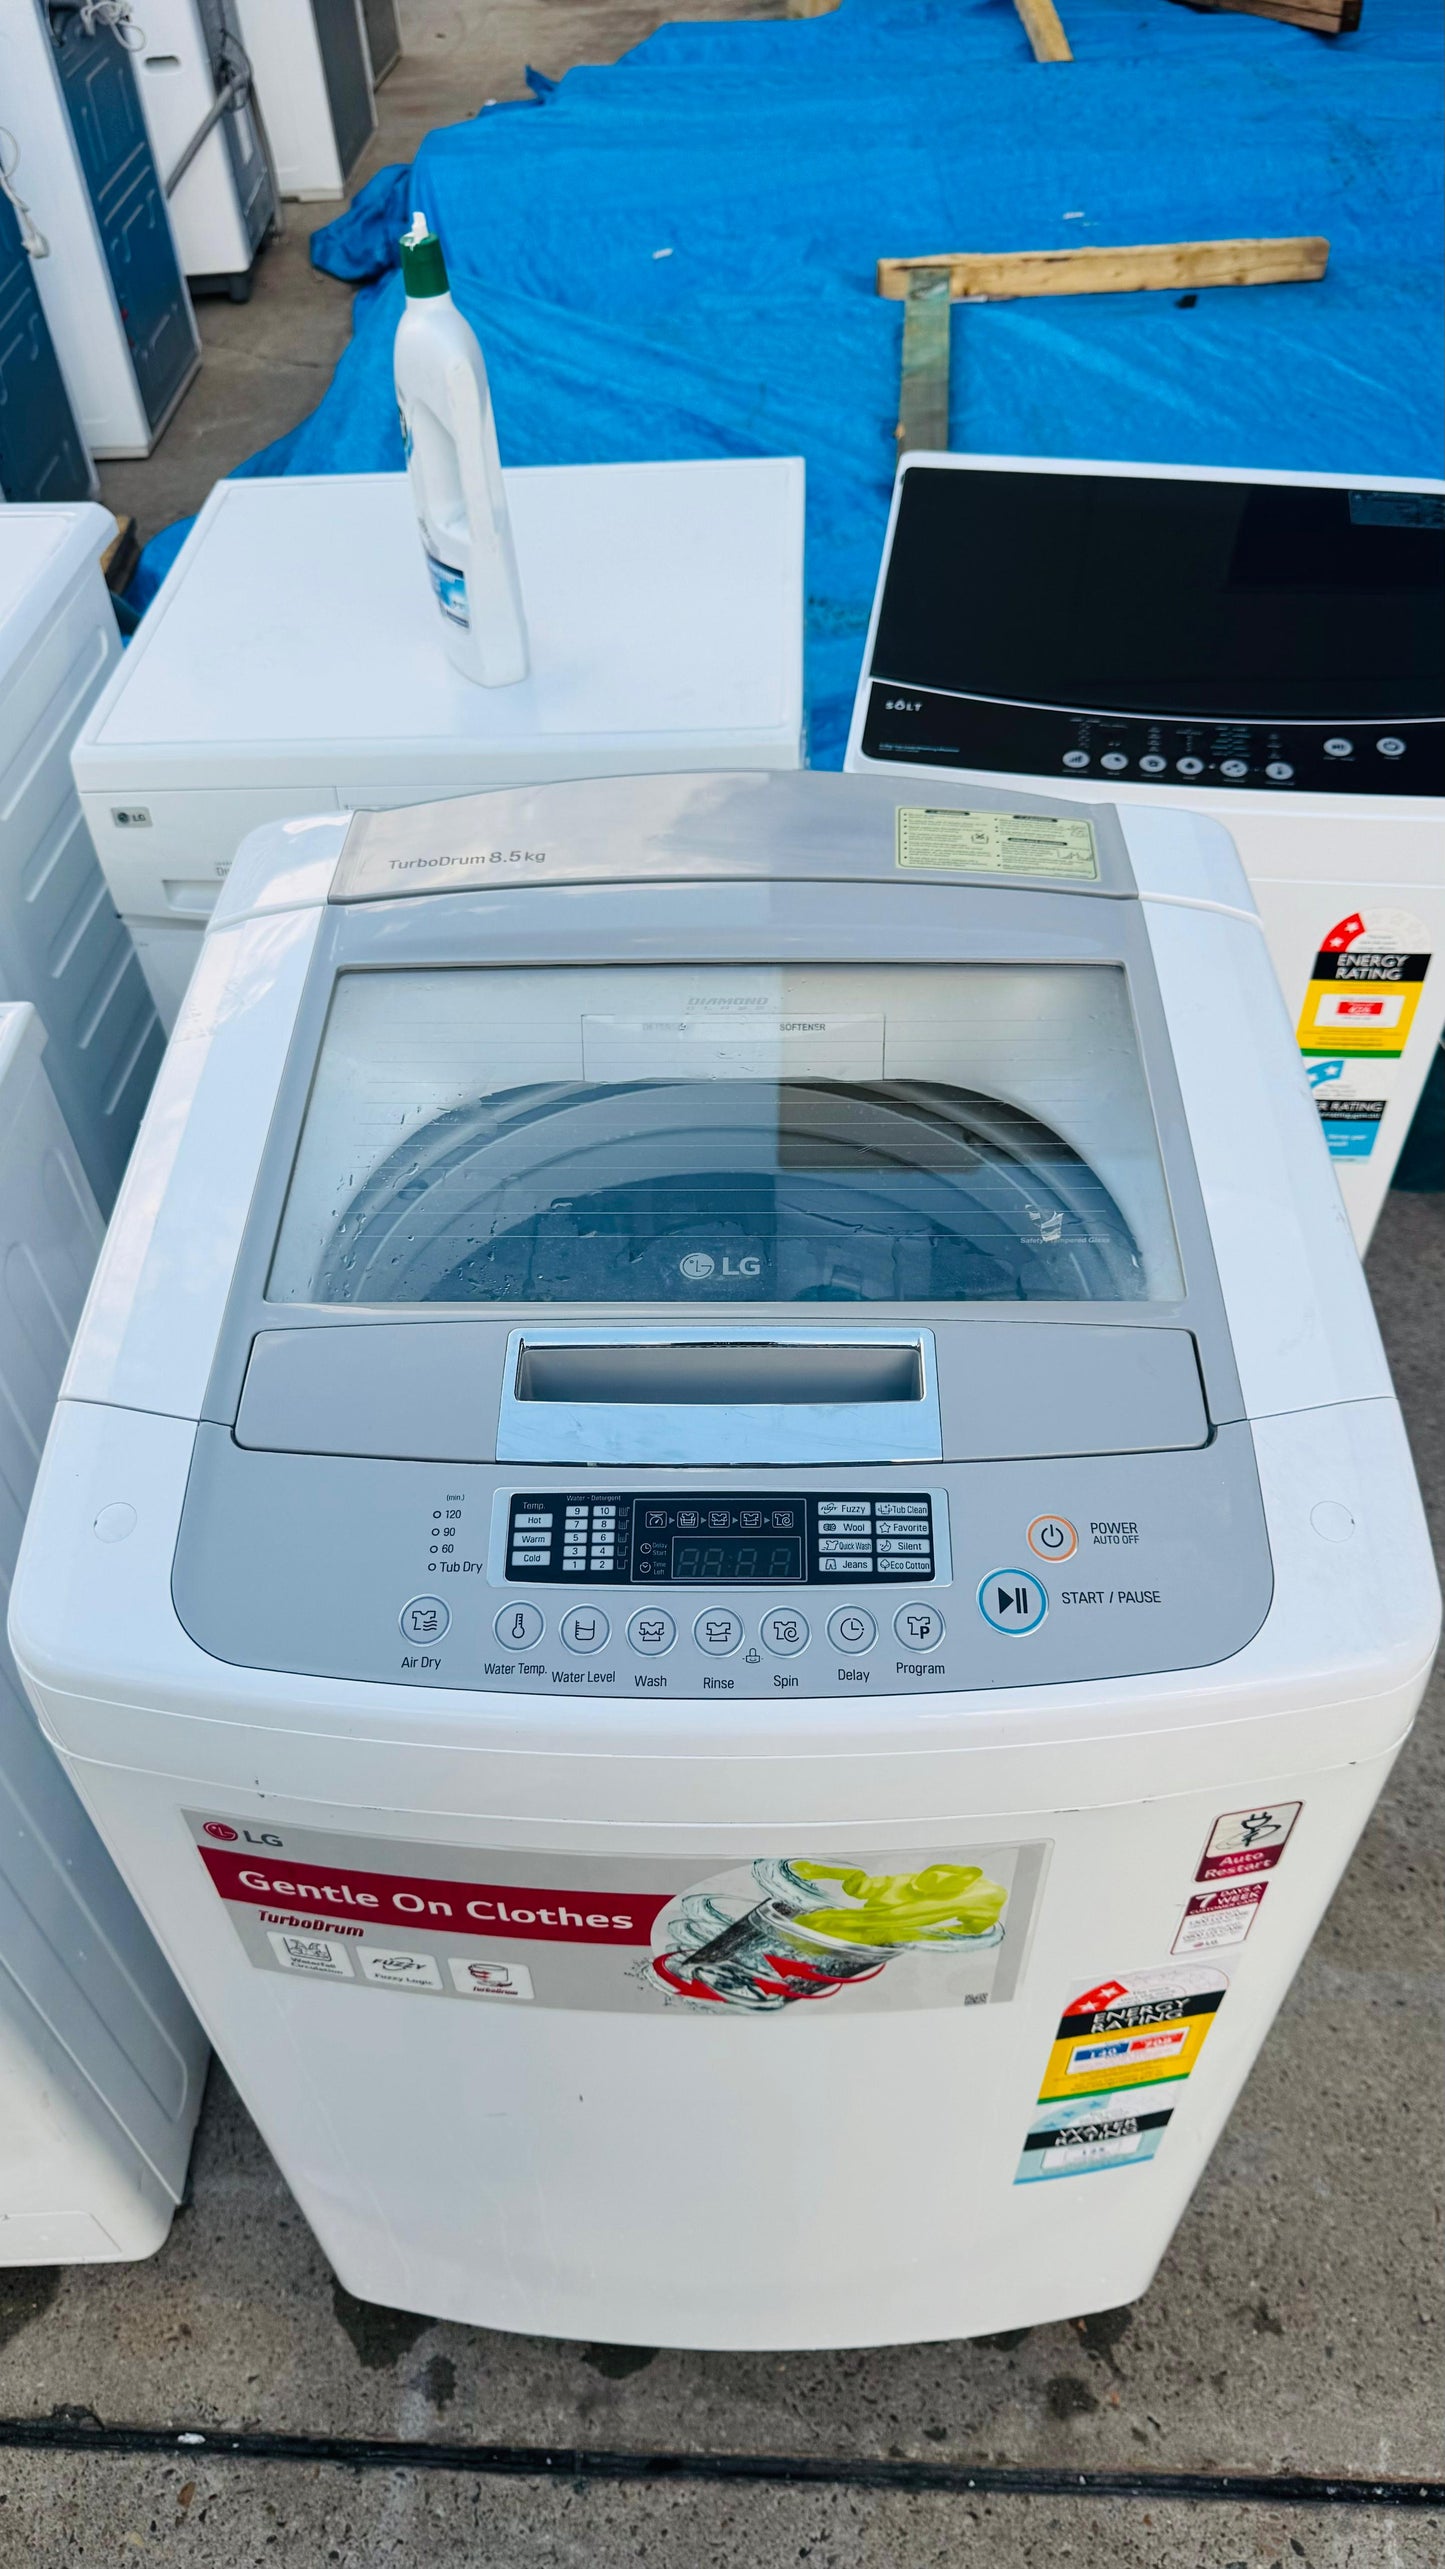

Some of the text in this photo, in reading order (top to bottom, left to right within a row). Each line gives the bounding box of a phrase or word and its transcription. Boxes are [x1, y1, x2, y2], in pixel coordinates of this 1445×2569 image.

[388, 850, 546, 870] TurboDrum 8.5 kg
[1337, 953, 1410, 968] ENERGY
[1335, 966, 1403, 981] RATING
[779, 1022, 826, 1032] SOFTENER
[1330, 1101, 1383, 1112] RATING
[722, 1256, 761, 1276] LG
[522, 1502, 546, 1511] Temp.
[574, 1507, 581, 1515] 9
[600, 1507, 610, 1515] 10
[841, 1504, 866, 1514] Fuzzy
[893, 1505, 928, 1514] Tub Clean
[445, 1509, 462, 1519] 120
[528, 1516, 542, 1524] Hot
[574, 1520, 580, 1528] 7
[601, 1520, 607, 1528] 8
[443, 1527, 456, 1537] 90
[843, 1523, 865, 1532] Wool
[893, 1523, 928, 1532] Favorite
[1090, 1522, 1138, 1534] POWER
[522, 1535, 546, 1543] Warm
[573, 1534, 579, 1542] 5
[600, 1534, 607, 1542] 6
[1093, 1535, 1140, 1545] AUTO OFF
[441, 1544, 454, 1554] 60
[839, 1541, 872, 1550] Quick Wash
[897, 1541, 922, 1551] Silent
[572, 1547, 578, 1555] 3
[599, 1547, 606, 1555] 4
[523, 1554, 541, 1562] Cold
[440, 1561, 483, 1575] Tub Dry
[599, 1561, 605, 1569] 2
[842, 1559, 868, 1569] Jeans
[890, 1560, 930, 1570] Eco Cotton
[1061, 1590, 1162, 1604] START / PAUSE
[401, 1656, 442, 1670] Air Dry
[484, 1662, 548, 1677] Water Temp.
[896, 1661, 946, 1676] Program
[551, 1671, 616, 1683] Water Level
[837, 1668, 870, 1683] Delay
[634, 1675, 667, 1687] Wash
[703, 1677, 735, 1689] Rinse
[773, 1675, 799, 1689] Spin
[242, 1830, 284, 1847] LG
[1218, 1852, 1266, 1867] Auto
[1204, 1859, 1273, 1879] Restart
[238, 1870, 634, 1930] Gentle On Clothes
[1195, 1892, 1218, 1909] 7
[258, 1909, 365, 1937] TurboDrum
[1093, 1998, 1190, 2023] ENERGY
[1091, 2009, 1184, 2034] RATING
[1055, 2127, 1137, 2147] RATING
